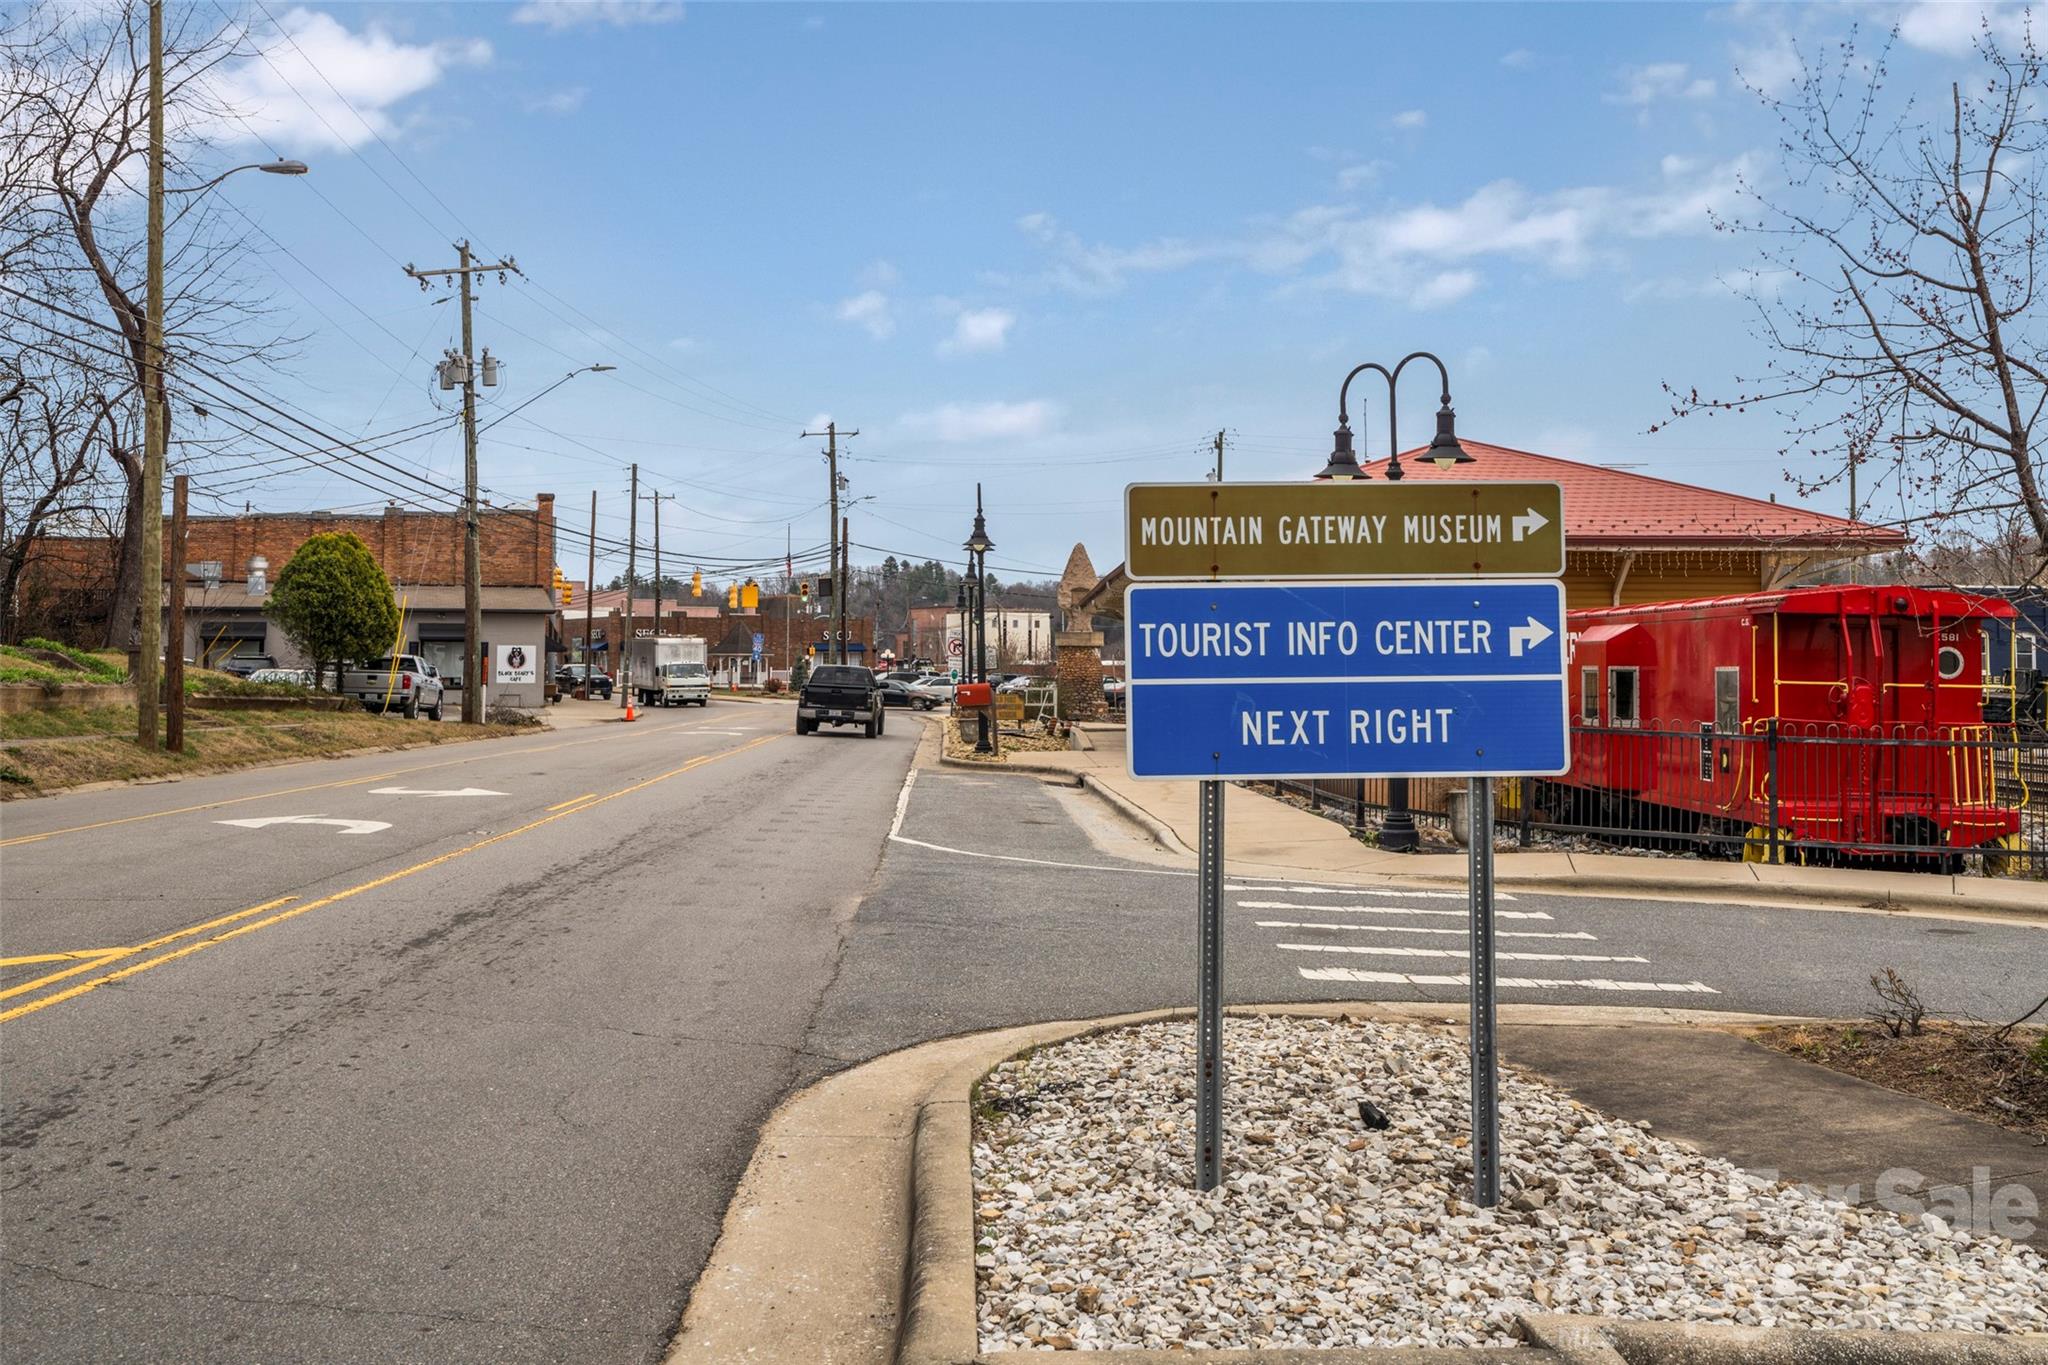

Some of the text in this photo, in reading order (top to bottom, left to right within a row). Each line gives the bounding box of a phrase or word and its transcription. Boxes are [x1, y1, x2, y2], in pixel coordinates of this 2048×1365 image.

[1141, 514, 1502, 545] MOUNTAIN GATEWAY MUSEUM
[1138, 619, 1492, 658] TOURIST INFO CENTER
[1938, 633, 1959, 642] 581
[1241, 708, 1453, 746] NEXT RIGHT
